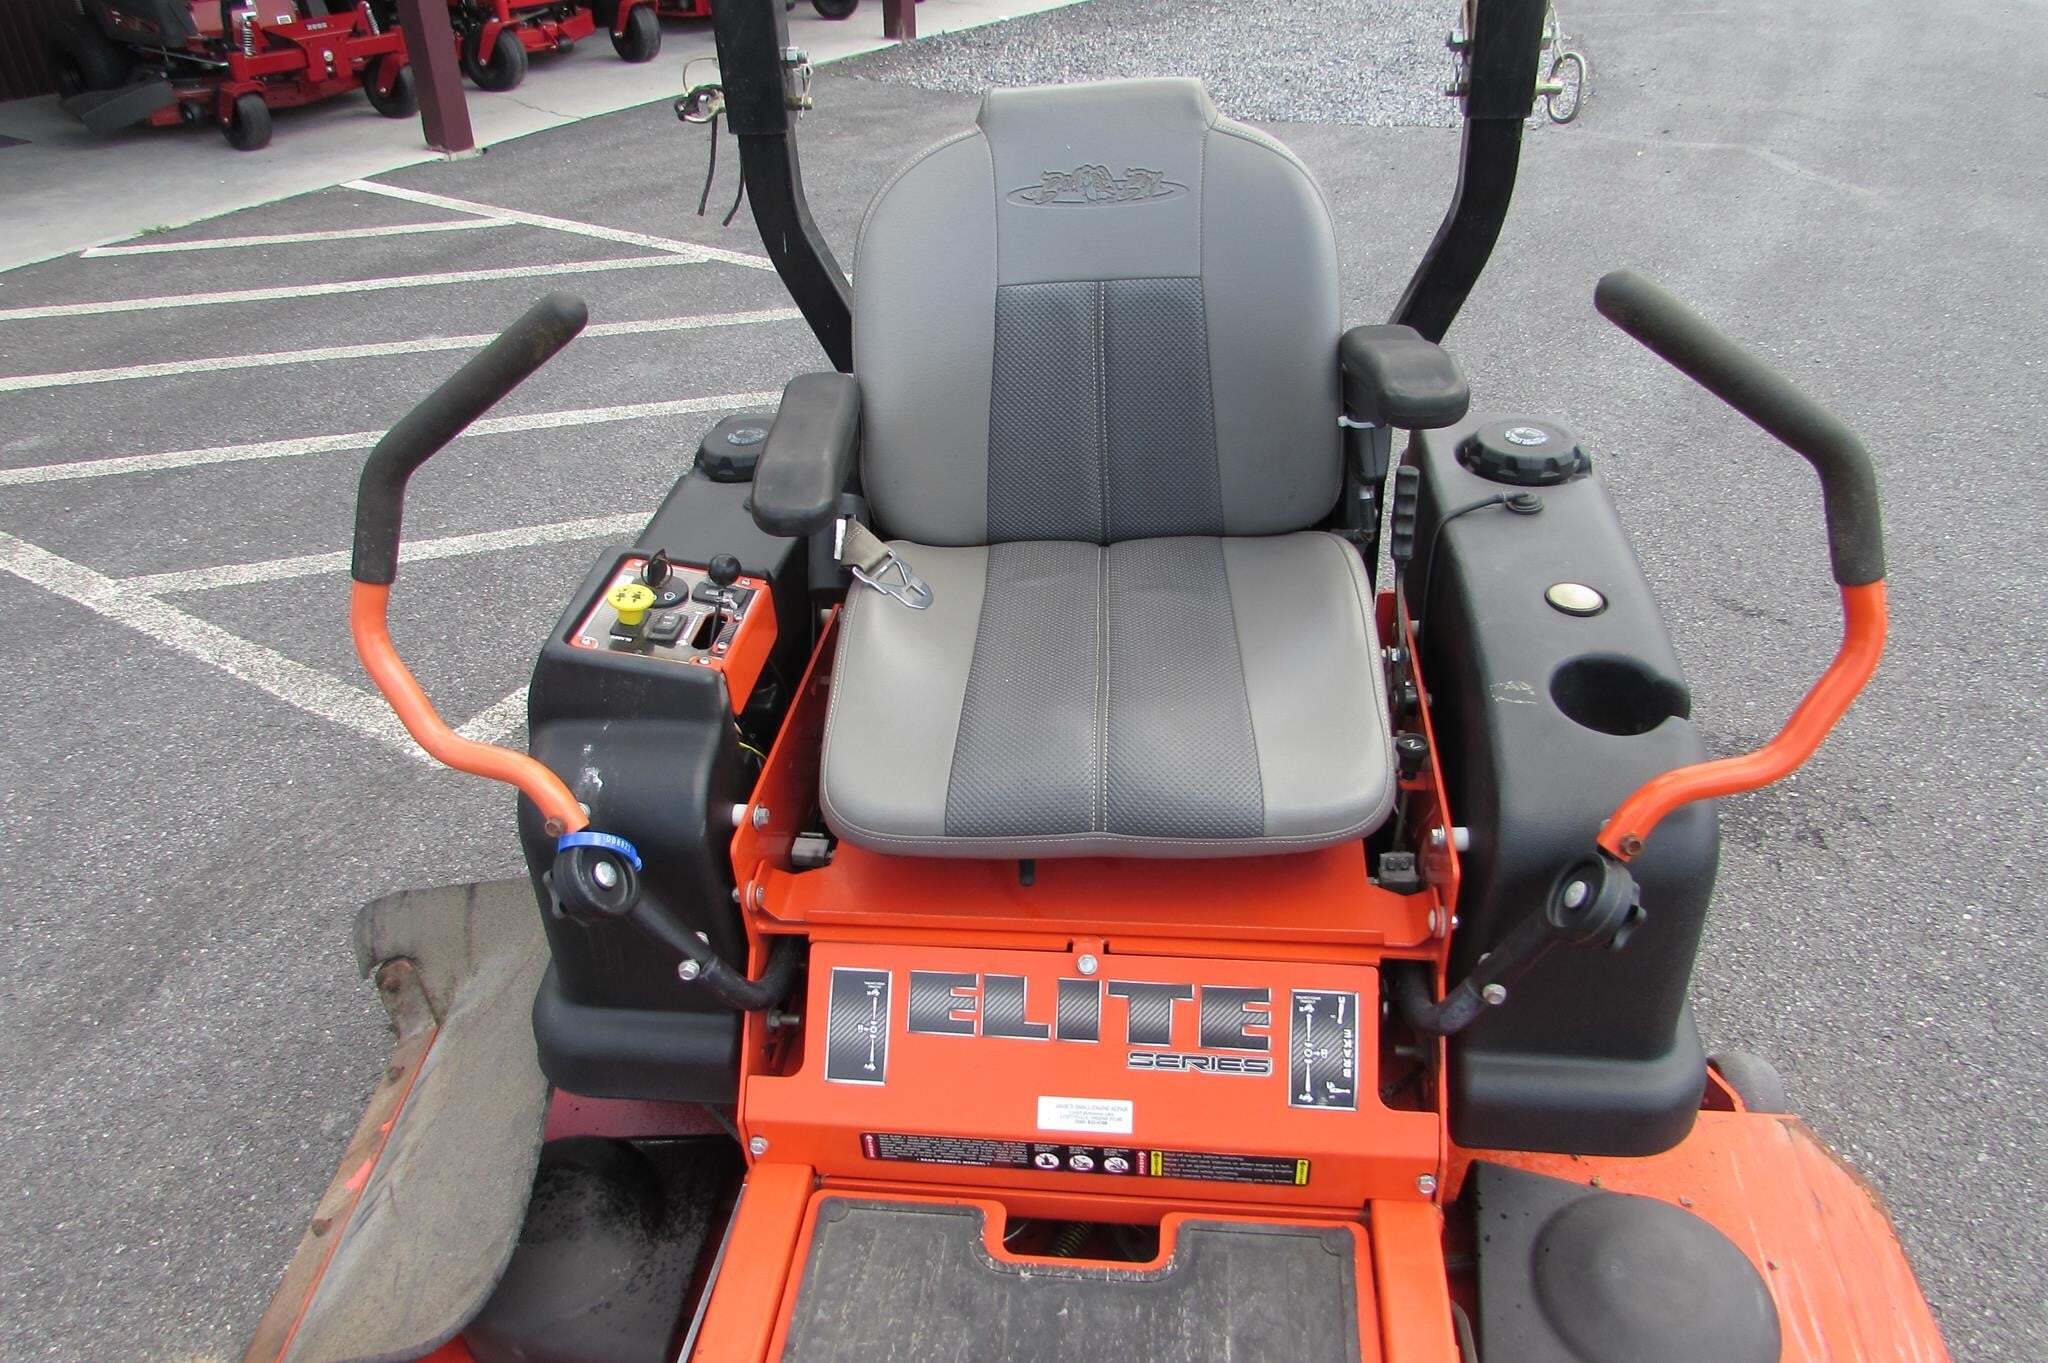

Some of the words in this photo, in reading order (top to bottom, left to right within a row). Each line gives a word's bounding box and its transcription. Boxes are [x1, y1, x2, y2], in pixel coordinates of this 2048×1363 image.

[907, 969, 1272, 1052] ELITE
[1128, 1050, 1273, 1076] SERIES
[1343, 1028, 1352, 1078] BRAKE
